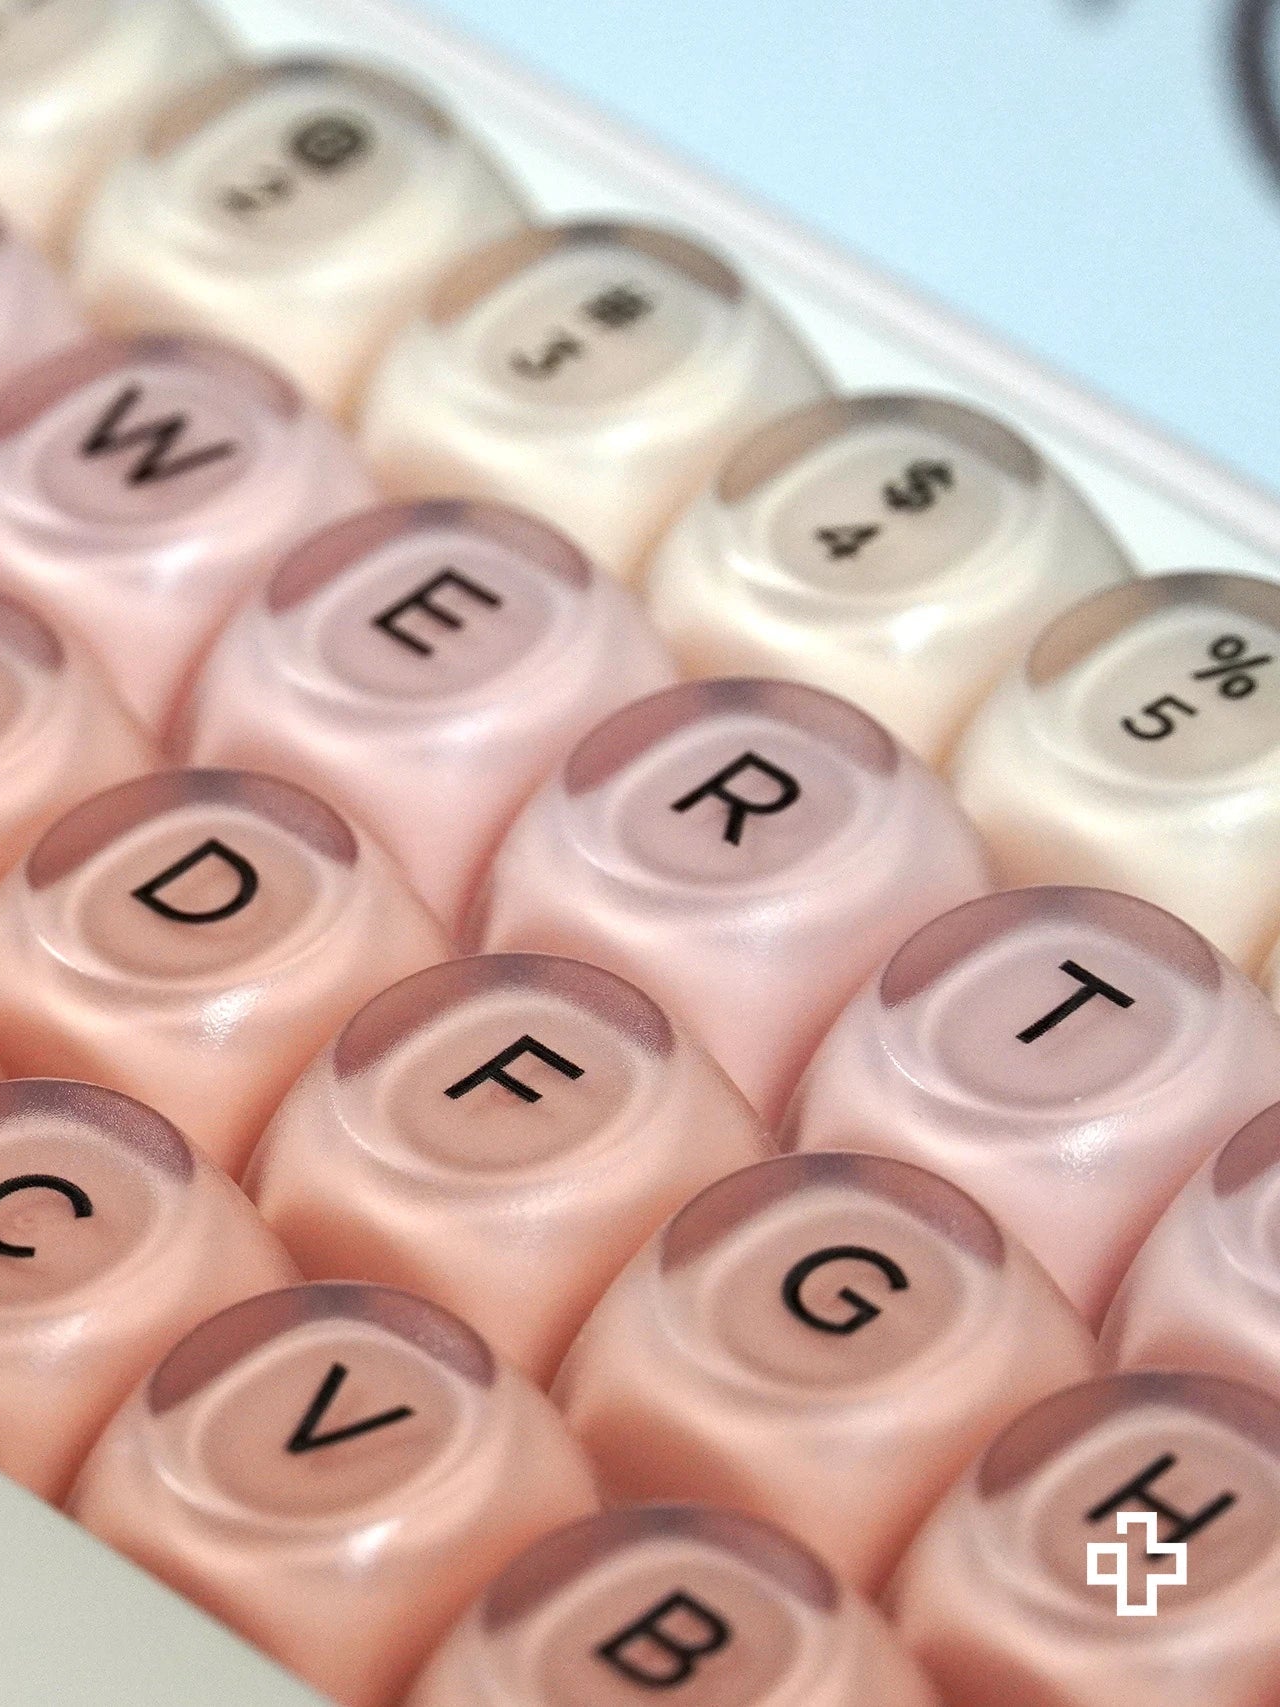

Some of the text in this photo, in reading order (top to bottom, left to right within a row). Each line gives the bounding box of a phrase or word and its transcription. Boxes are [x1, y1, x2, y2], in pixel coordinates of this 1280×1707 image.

[81, 384, 237, 487] W
[882, 459, 954, 514] $
[816, 521, 880, 561] 4
[371, 568, 501, 657] E
[1194, 636, 1271, 700] %
[1122, 696, 1196, 741] 5
[671, 752, 800, 846] R
[131, 839, 258, 925] D
[1016, 960, 1135, 1044] T
[444, 1035, 585, 1103] F
[781, 1246, 909, 1337] G
[285, 1363, 413, 1456] V
[1085, 1453, 1237, 1564] H
[595, 1591, 731, 1691] B
